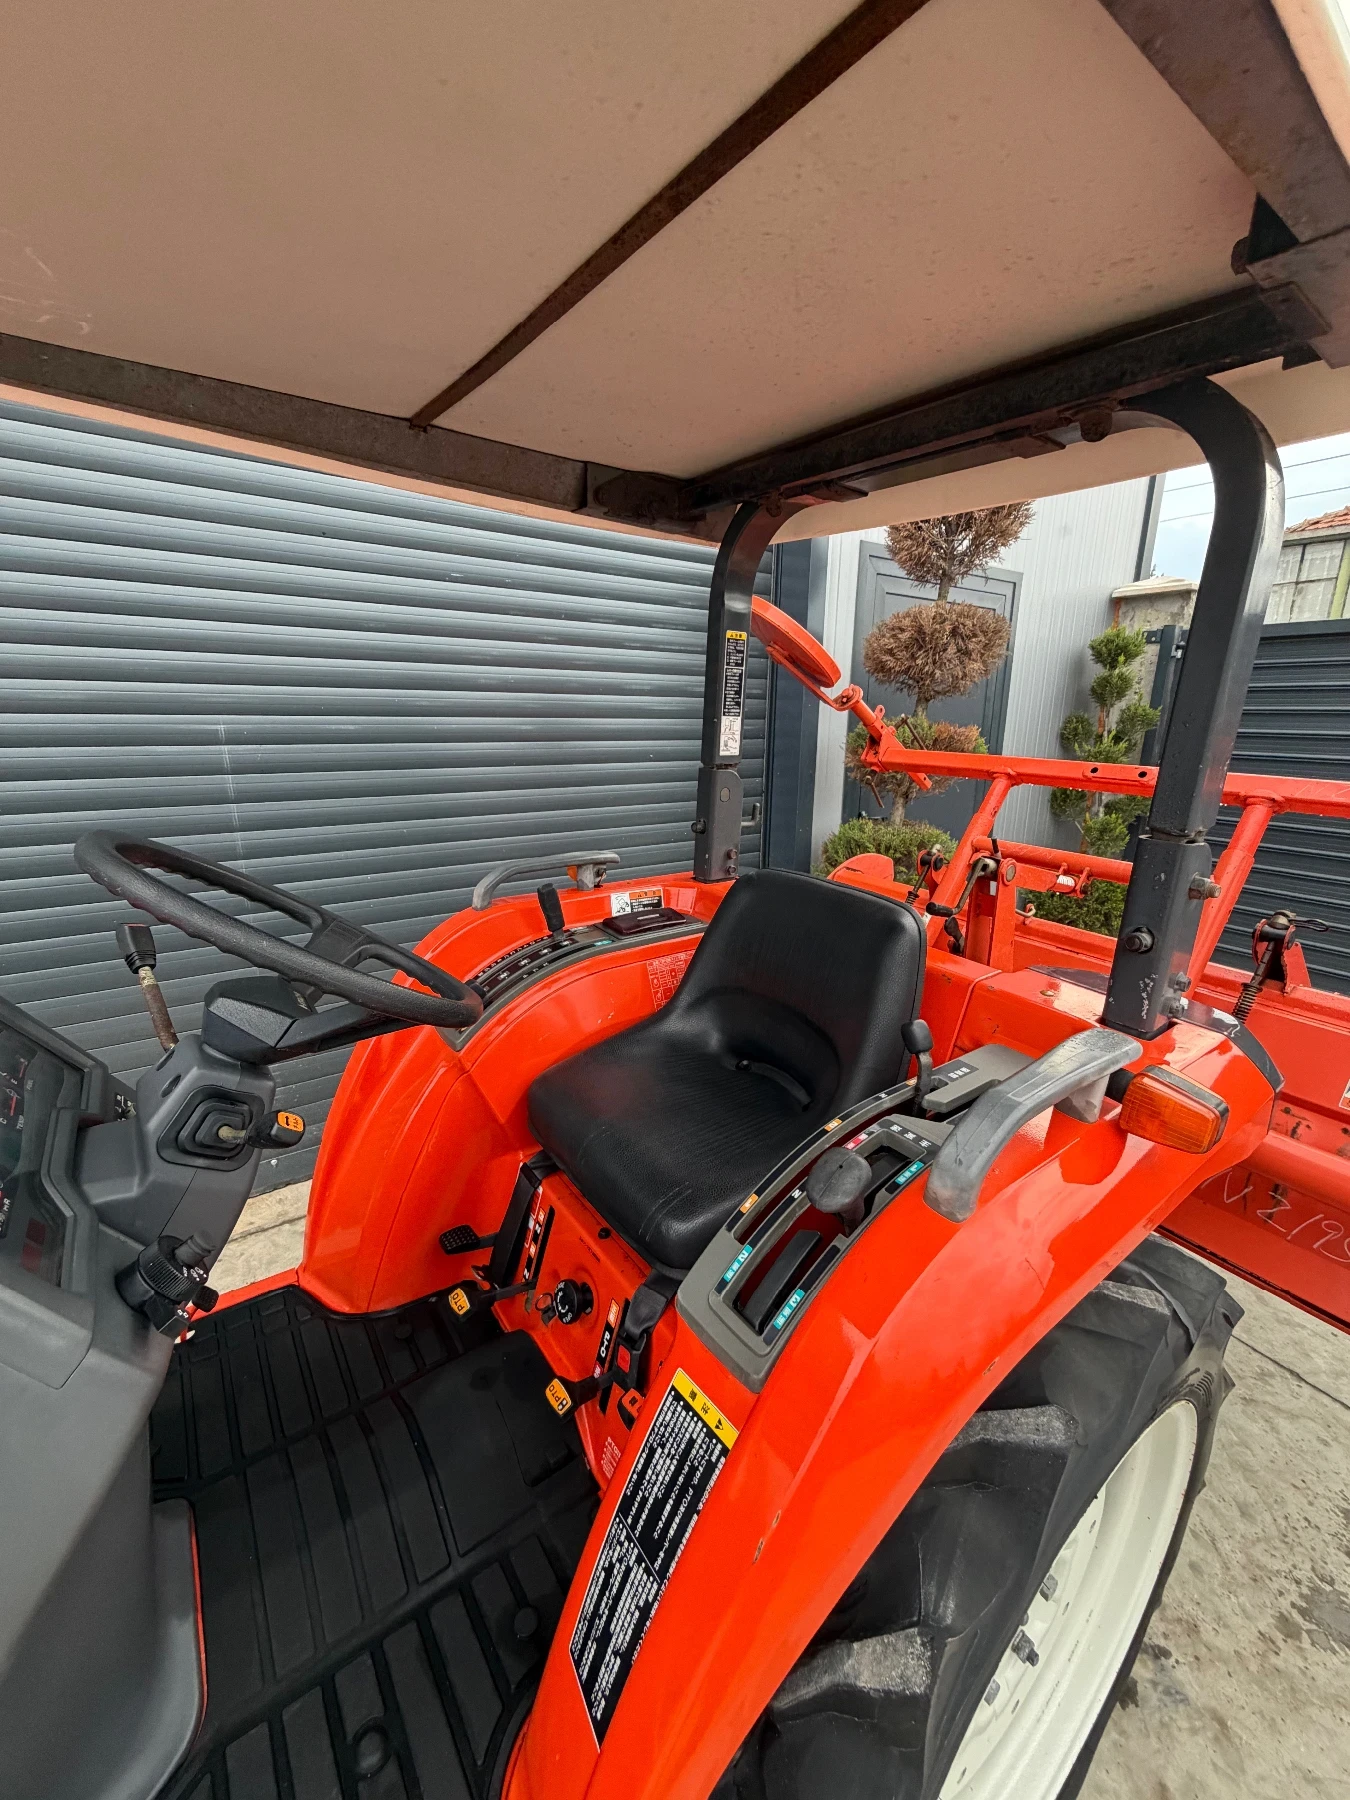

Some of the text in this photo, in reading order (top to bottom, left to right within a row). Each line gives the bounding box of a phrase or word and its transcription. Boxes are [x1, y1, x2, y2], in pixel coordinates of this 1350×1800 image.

[792, 1189, 802, 1199] N
[452, 1291, 465, 1312] PTO
[599, 1330, 611, 1358] PTO
[547, 1384, 563, 1403] PTO
[692, 1435, 709, 1467] にすること
